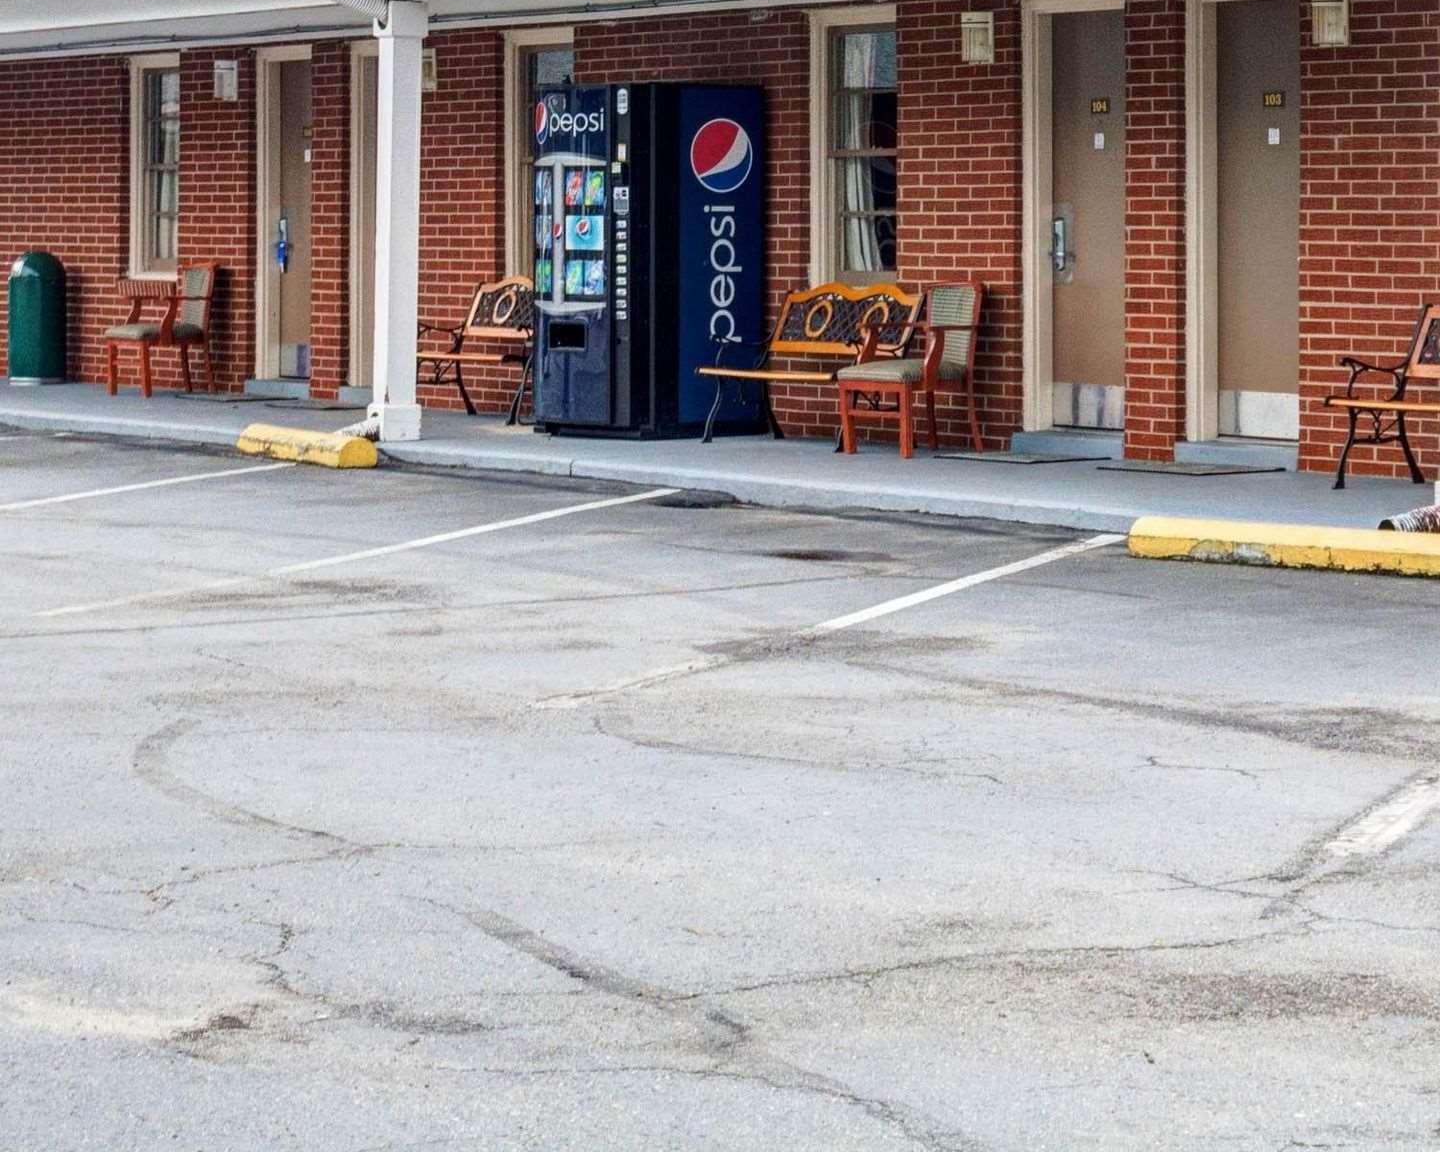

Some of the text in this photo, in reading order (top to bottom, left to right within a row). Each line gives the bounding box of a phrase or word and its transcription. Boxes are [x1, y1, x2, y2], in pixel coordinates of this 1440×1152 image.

[1264, 93, 1282, 106] 103
[549, 107, 604, 138] pepsi
[703, 205, 742, 344] pepsi
